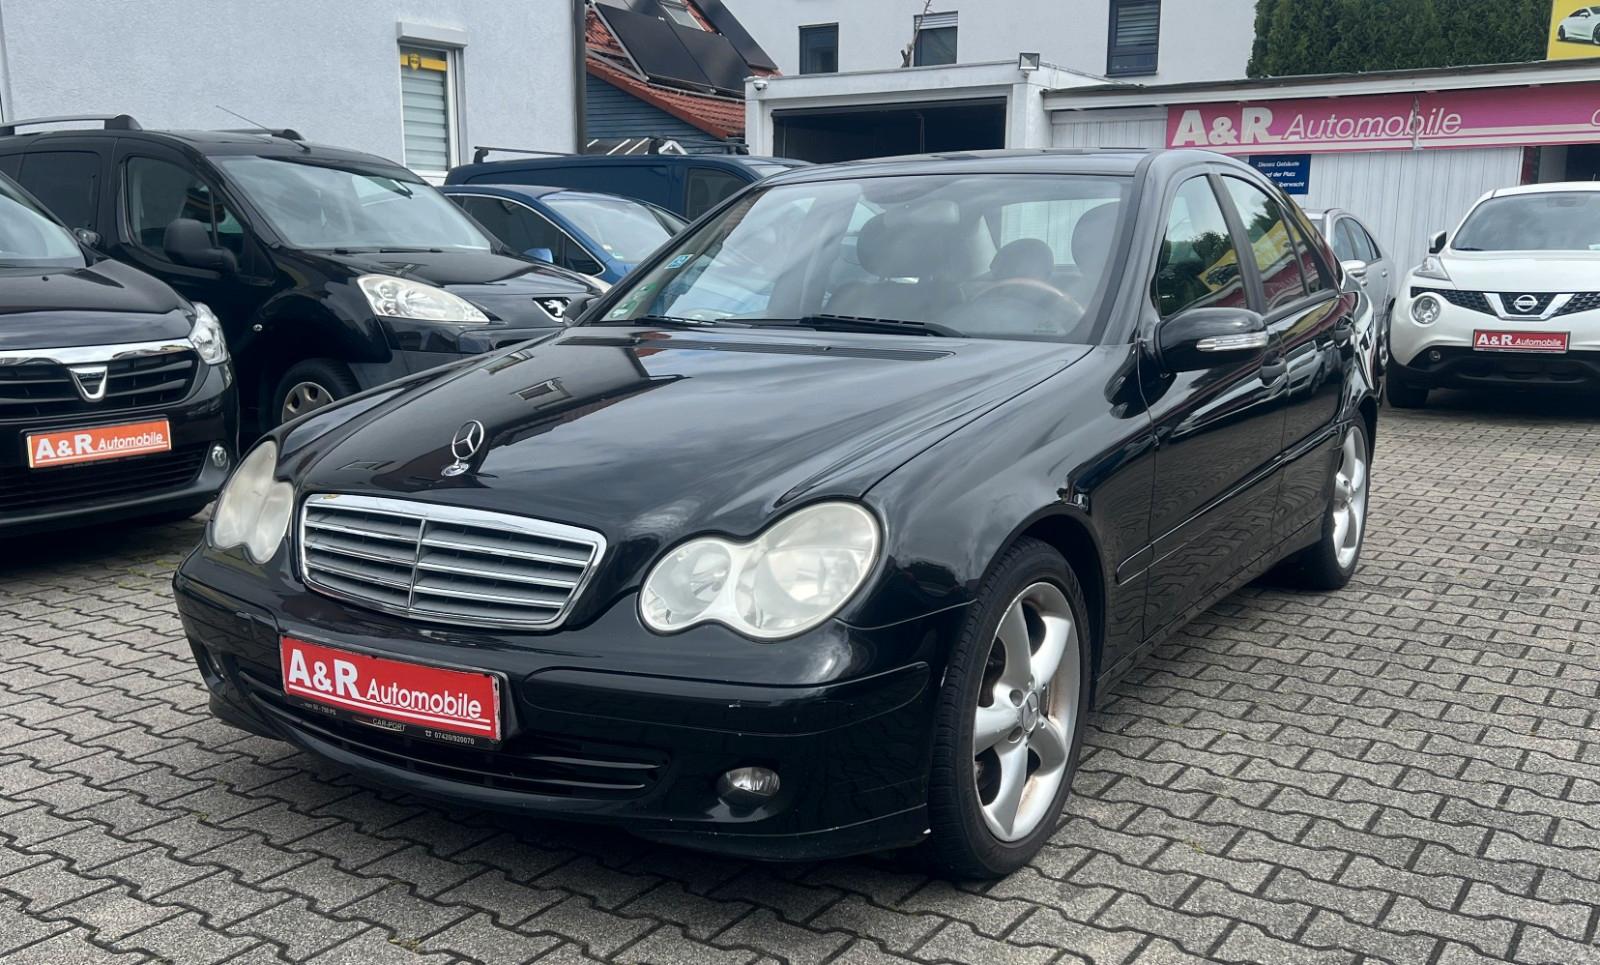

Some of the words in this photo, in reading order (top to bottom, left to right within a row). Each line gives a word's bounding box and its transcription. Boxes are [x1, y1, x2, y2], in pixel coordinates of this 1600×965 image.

[1171, 106, 1274, 147] A&R
[1282, 106, 1462, 141] Automobile
[1477, 334, 1513, 345] A&R
[1515, 338, 1561, 346] Automobile
[35, 433, 96, 460] A&R
[98, 432, 163, 451] Automobile
[288, 649, 361, 698] A&R
[366, 678, 481, 718] Automobile
[373, 718, 406, 731] CAR-PORT
